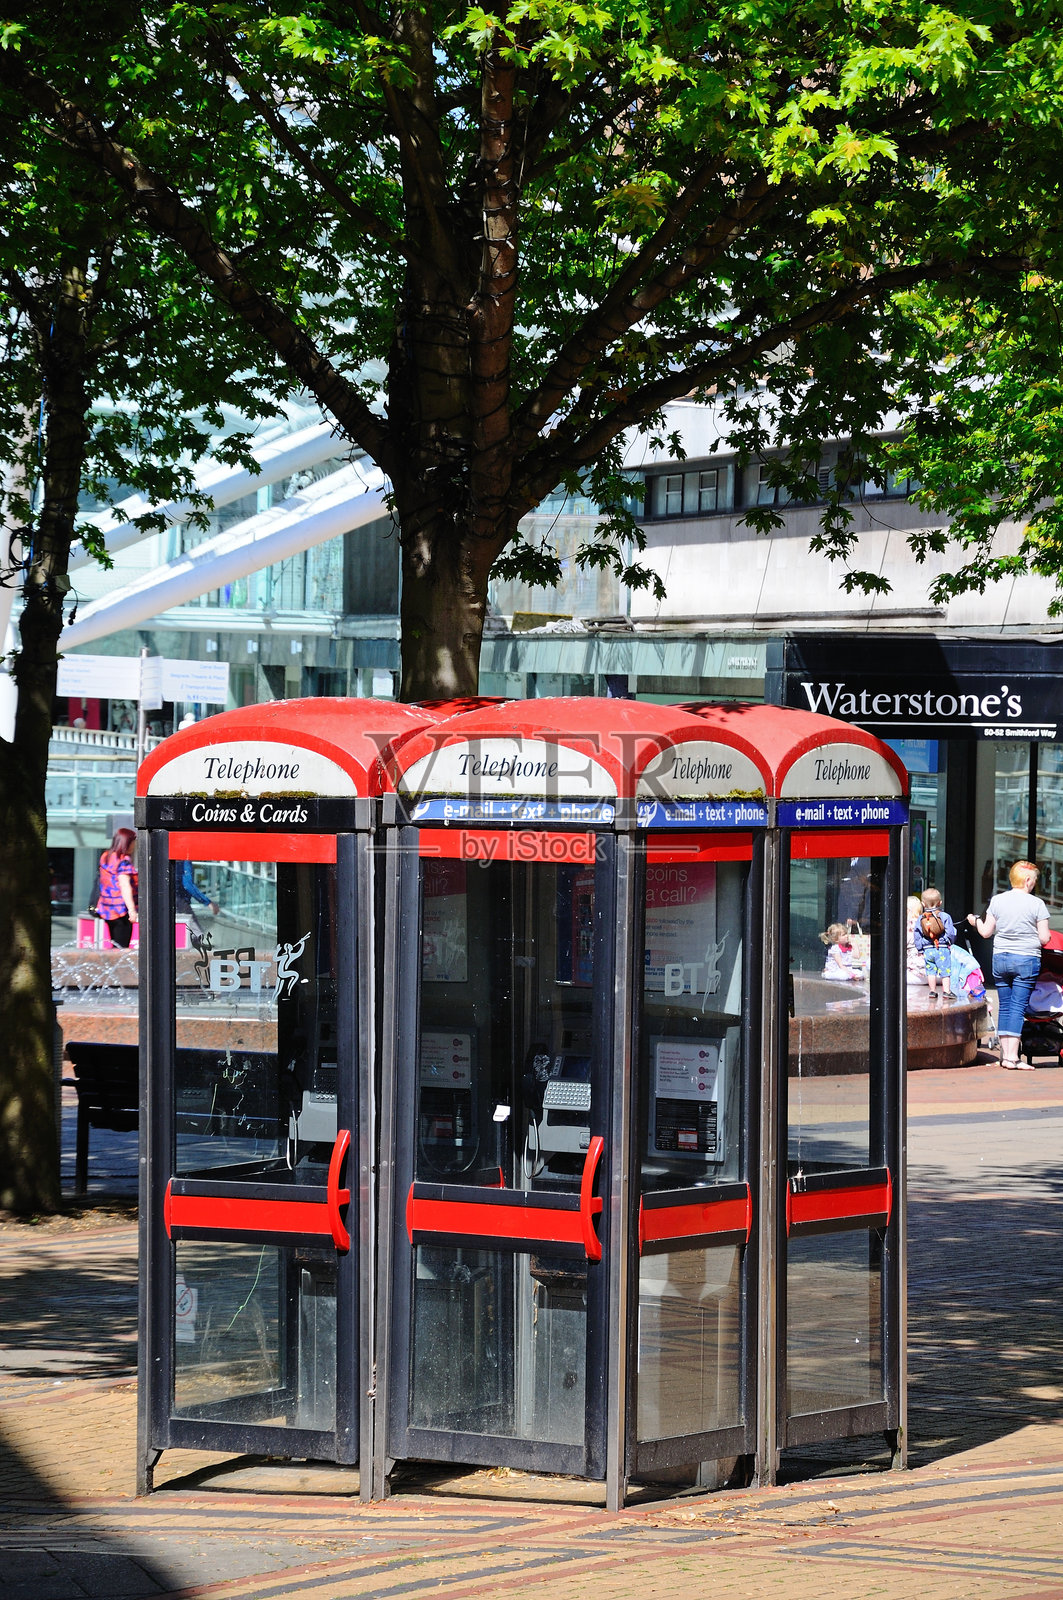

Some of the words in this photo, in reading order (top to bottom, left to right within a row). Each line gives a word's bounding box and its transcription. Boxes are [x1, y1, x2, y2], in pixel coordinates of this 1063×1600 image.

[800, 682, 1022, 718] Waterstone's
[984, 728, 1005, 737] 50-52
[1005, 728, 1040, 737] Smithford
[1040, 729, 1057, 739] Way
[204, 757, 300, 783] Telephone
[458, 754, 558, 781] Telephone
[672, 757, 733, 784] Telephone
[815, 759, 871, 785] Telephone
[192, 803, 238, 822] Coins
[240, 803, 256, 822] &
[260, 803, 308, 823] Cards
[443, 802, 494, 819] e-mail
[510, 803, 544, 820] text
[560, 803, 612, 823] phone
[665, 803, 696, 821] e-mail
[705, 805, 726, 821] text
[734, 803, 765, 825] phone
[795, 803, 825, 820] e-mail
[833, 805, 853, 820] text
[861, 803, 890, 824] phone
[645, 865, 688, 882] coins
[645, 888, 656, 901] a
[660, 886, 697, 902] call?
[210, 960, 271, 993] BT
[664, 962, 705, 997] BT
